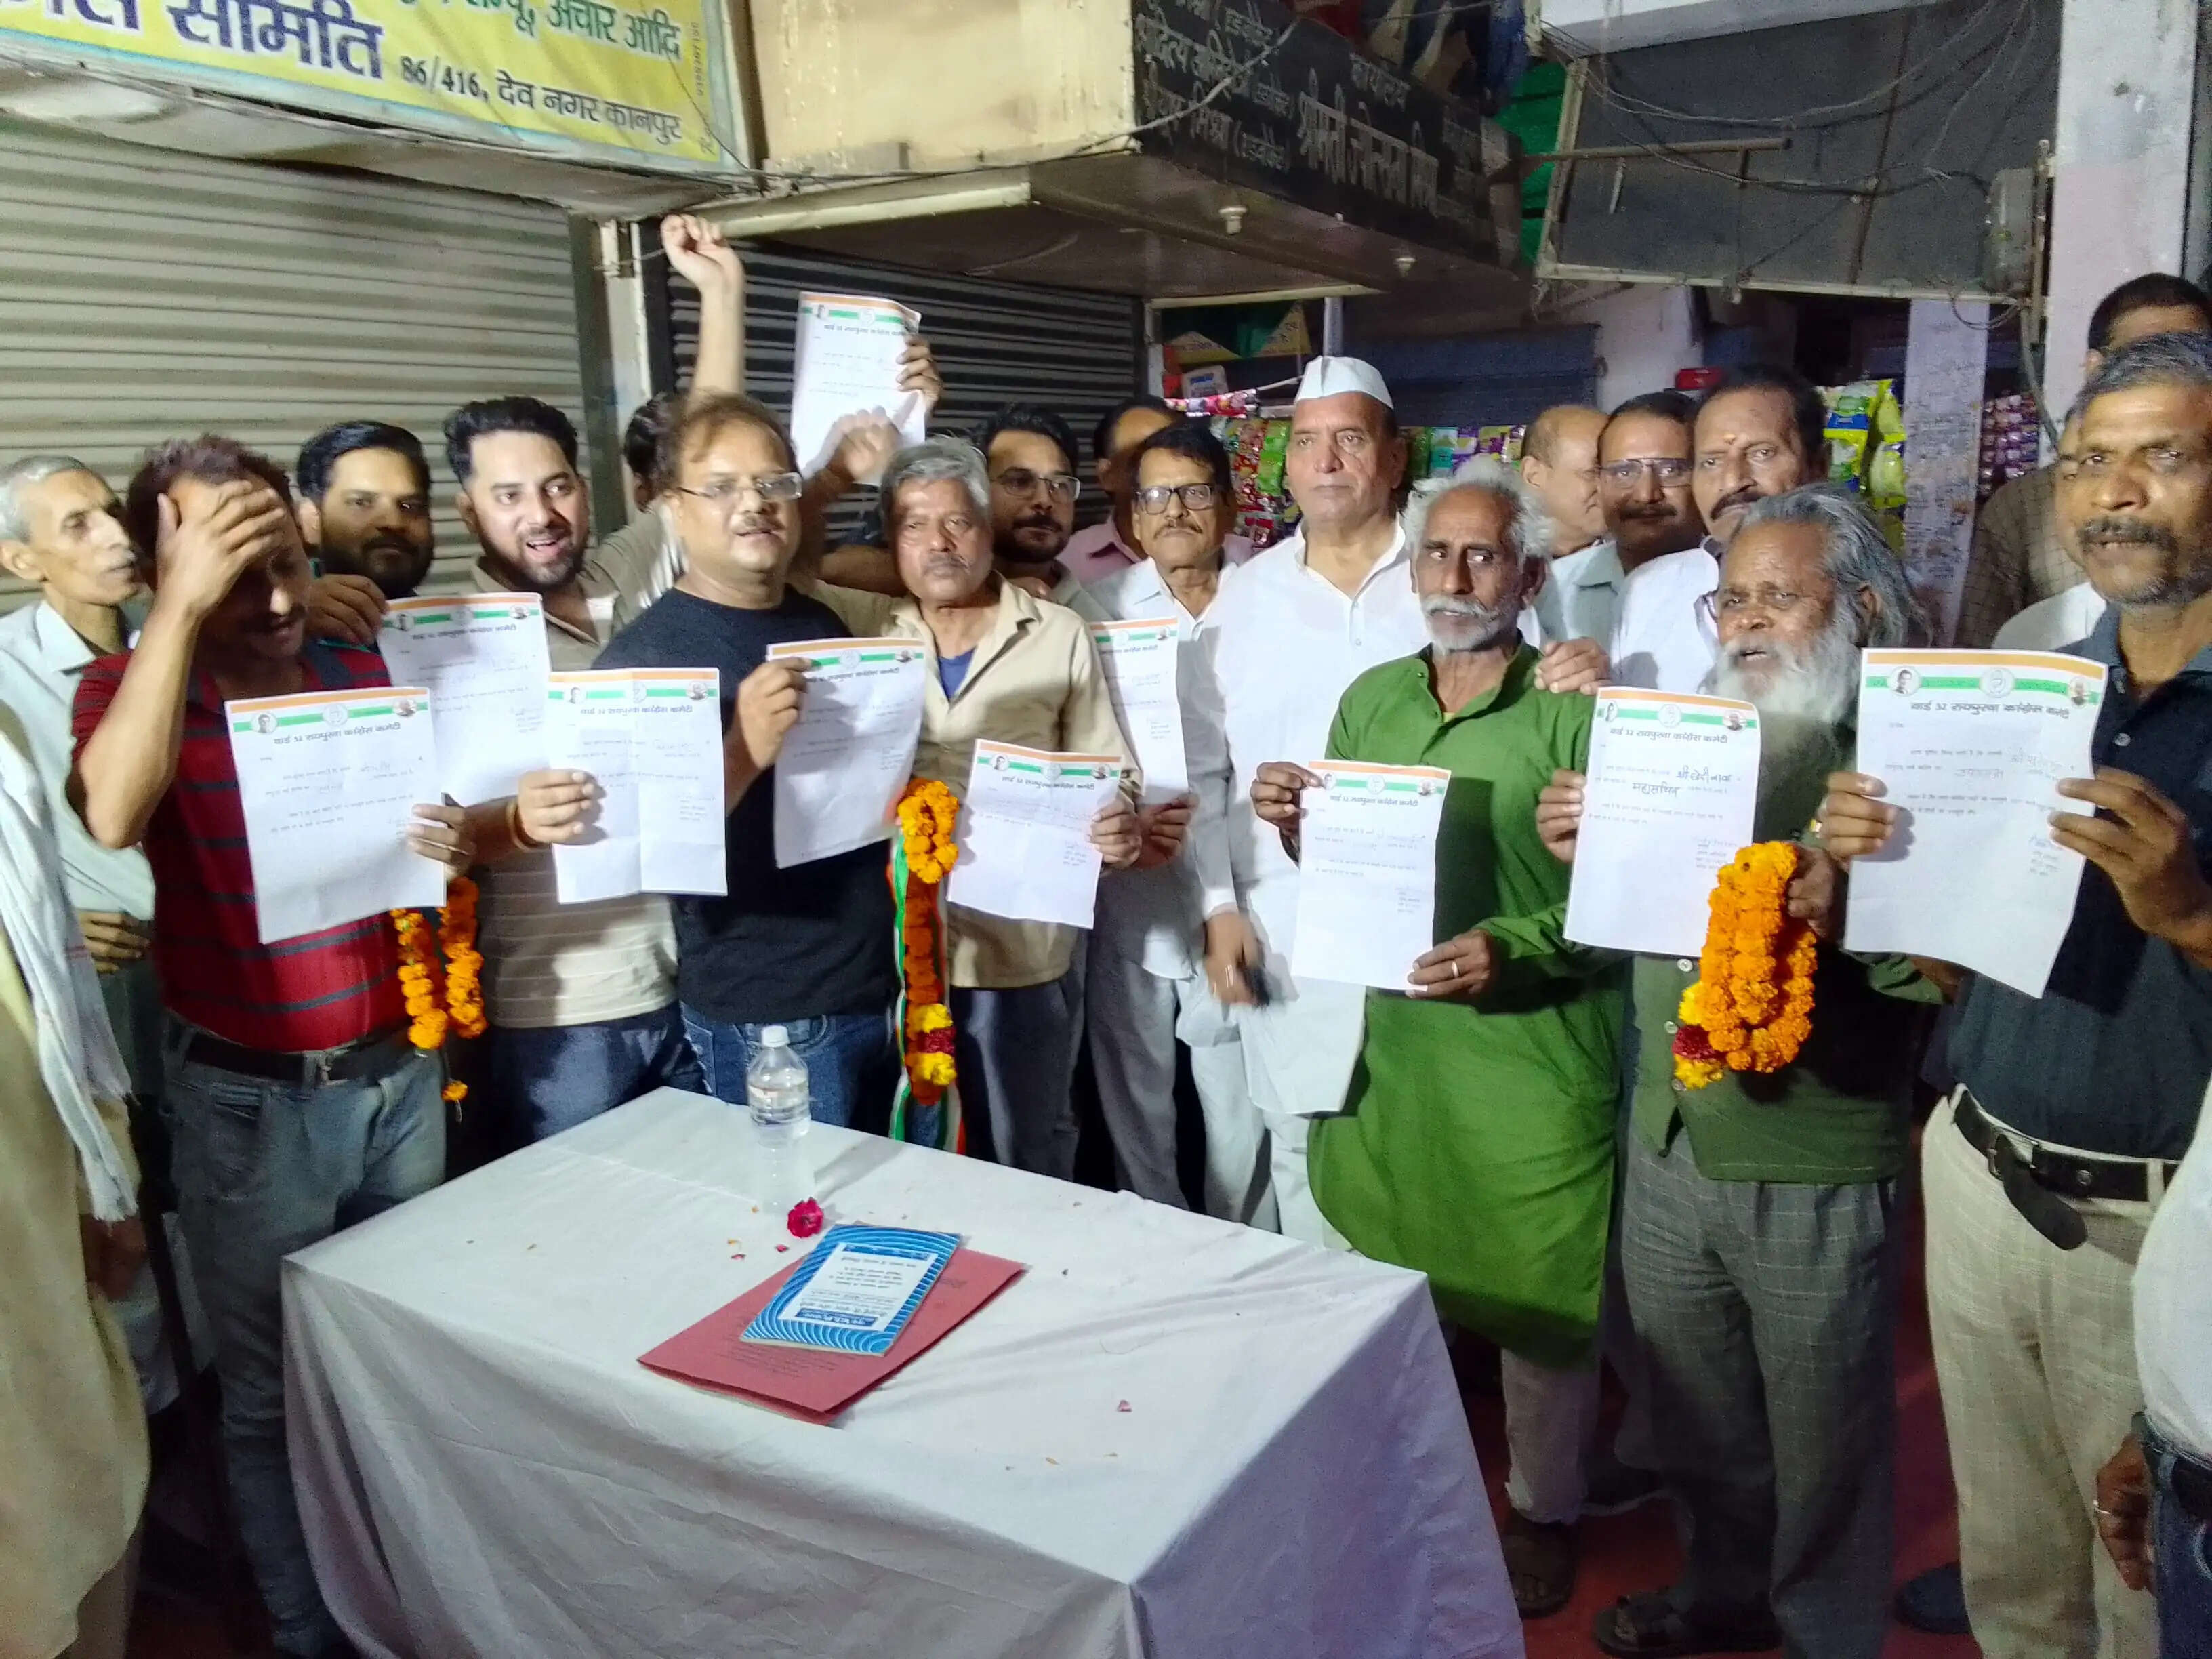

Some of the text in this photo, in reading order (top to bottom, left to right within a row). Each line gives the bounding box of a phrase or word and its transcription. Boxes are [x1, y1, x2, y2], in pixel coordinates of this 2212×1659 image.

[623, 9, 681, 59] आदि
[400, 55, 682, 145] 86/416, देव नगर कानपुर
